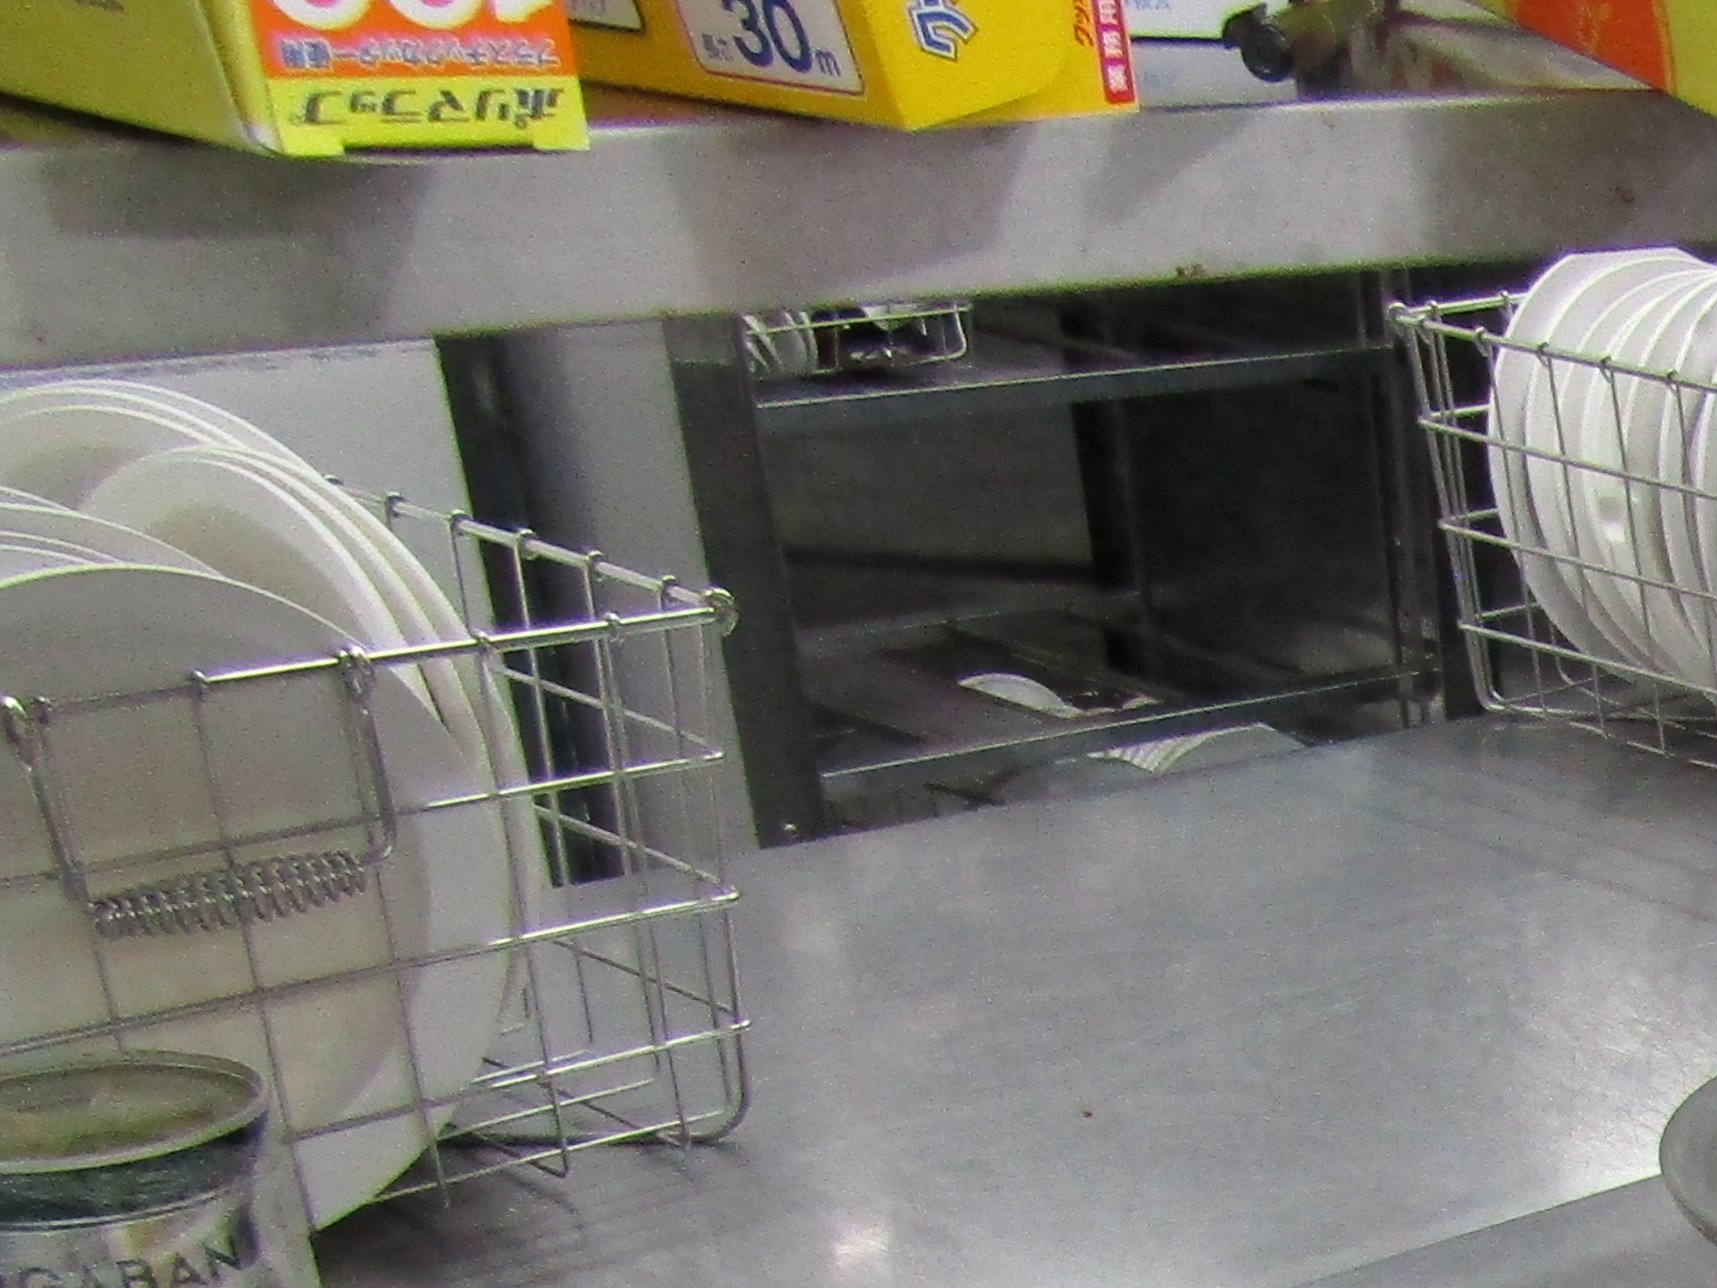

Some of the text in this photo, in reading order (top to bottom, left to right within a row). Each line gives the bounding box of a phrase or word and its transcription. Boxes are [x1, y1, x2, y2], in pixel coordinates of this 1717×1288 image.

[289, 88, 564, 129] ポリマラップ
